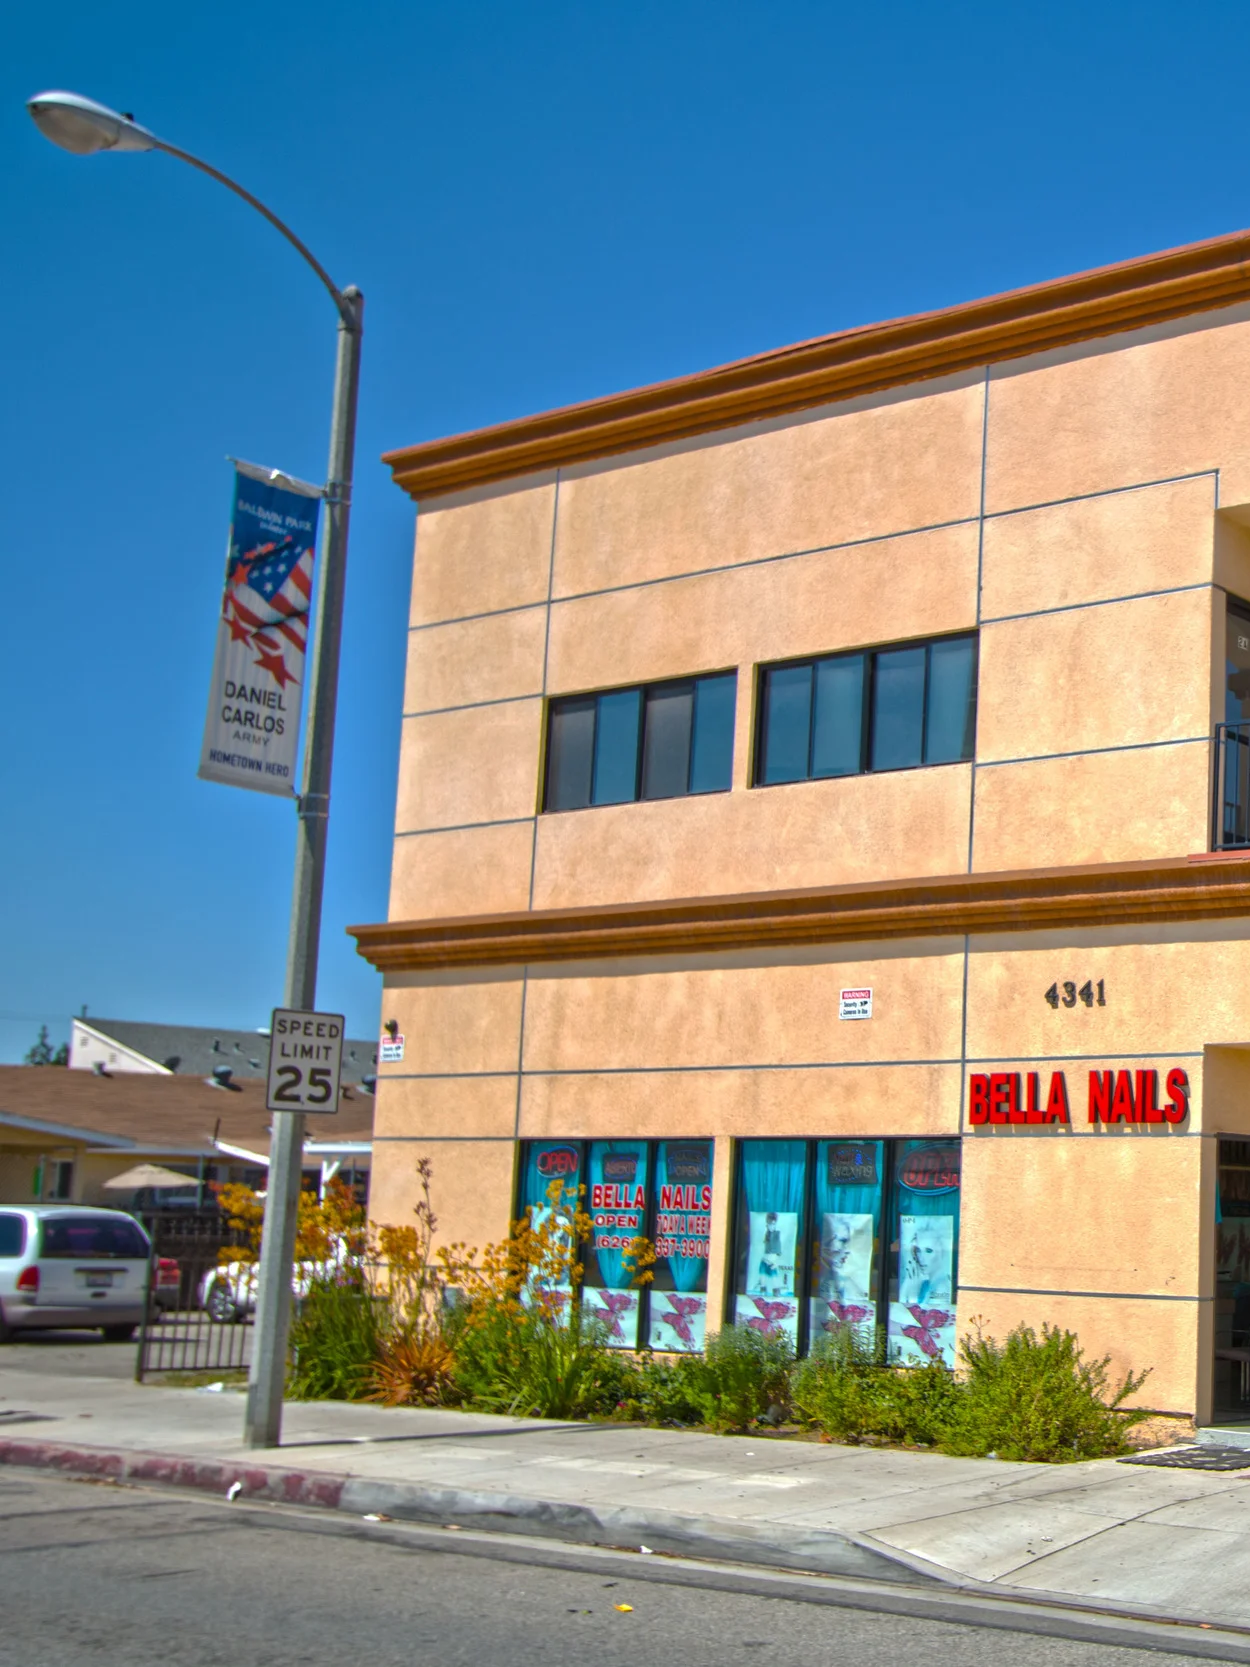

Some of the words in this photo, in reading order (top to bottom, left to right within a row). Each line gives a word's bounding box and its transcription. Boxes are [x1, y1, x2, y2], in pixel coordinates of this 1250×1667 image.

[224, 680, 287, 711] DANIEL
[222, 704, 285, 735] CARLOS
[232, 730, 270, 747] ARMY
[209, 747, 263, 772] HOMETOWN
[265, 761, 289, 778] HERO
[1044, 978, 1106, 1009] 4341
[277, 1019, 340, 1039] SPEED
[280, 1042, 332, 1061] LIMIT
[274, 1065, 332, 1103] 25
[969, 1071, 1071, 1125] BELLA
[1088, 1067, 1190, 1124] NAILS
[537, 1152, 579, 1173] OPEN
[591, 1183, 645, 1210] BELLA
[660, 1184, 713, 1211] NAILS
[594, 1213, 639, 1229] OPEN
[655, 1236, 711, 1260] 337-3900
